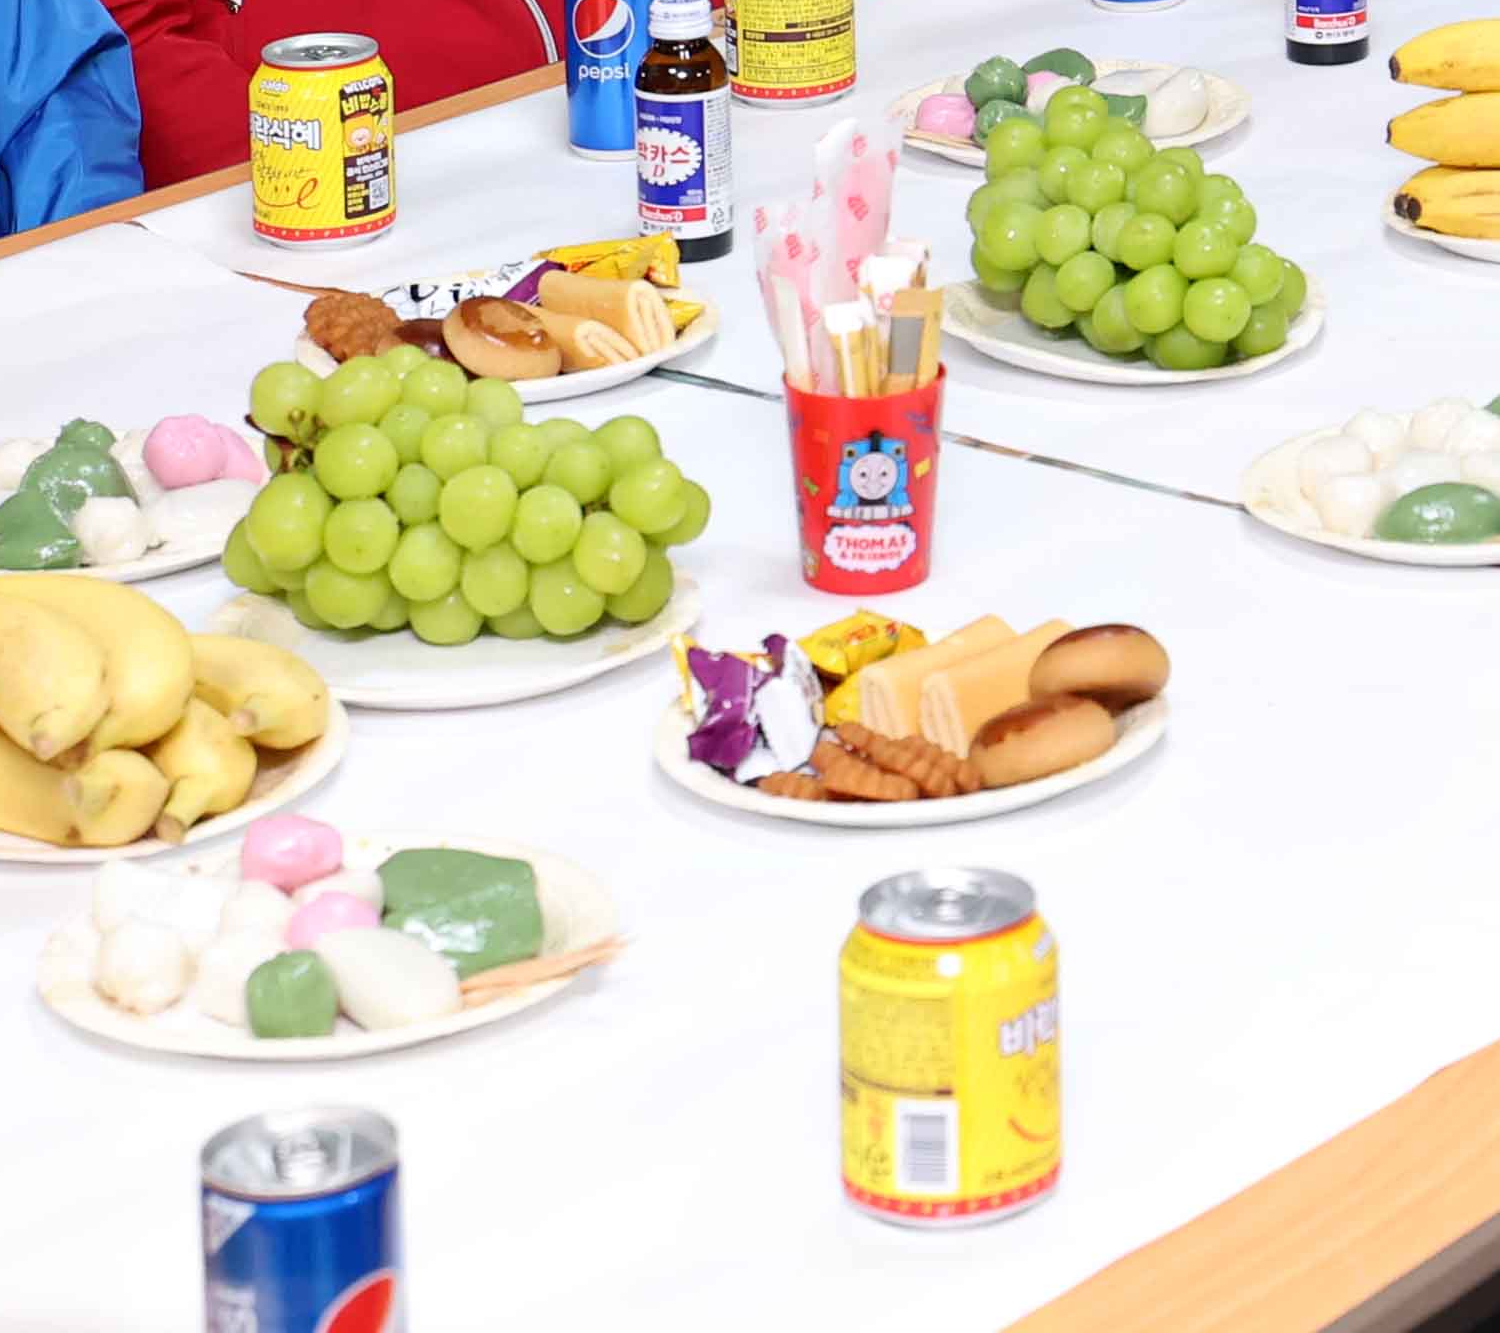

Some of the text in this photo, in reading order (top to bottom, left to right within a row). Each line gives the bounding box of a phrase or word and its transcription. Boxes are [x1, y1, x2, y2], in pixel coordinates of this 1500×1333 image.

[579, 62, 631, 83] pepsi
[653, 164, 665, 177] D
[835, 534, 907, 550] THOMAS
